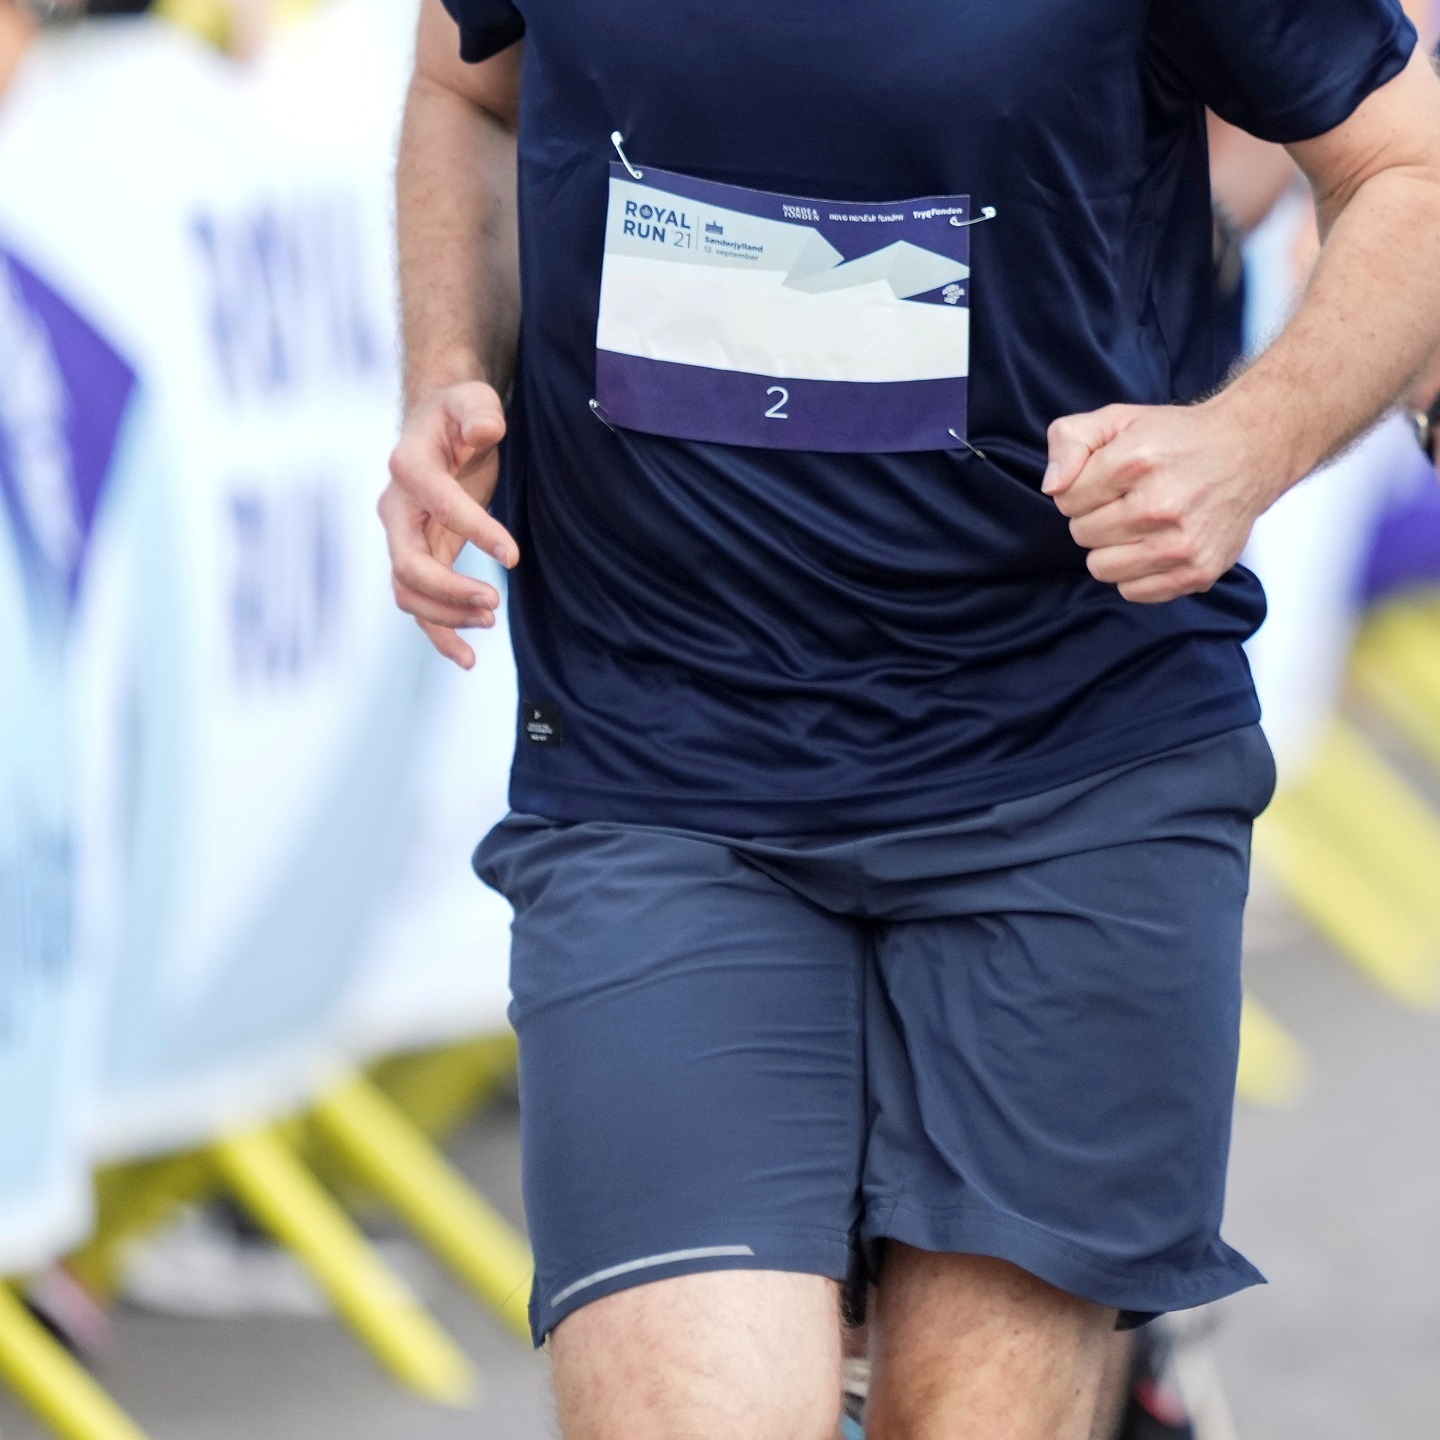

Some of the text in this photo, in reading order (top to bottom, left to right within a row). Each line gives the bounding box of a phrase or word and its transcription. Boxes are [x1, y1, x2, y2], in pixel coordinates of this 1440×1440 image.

[625, 200, 691, 229] ROYAL
[623, 219, 666, 244] RUN
[764, 386, 790, 419] 2
